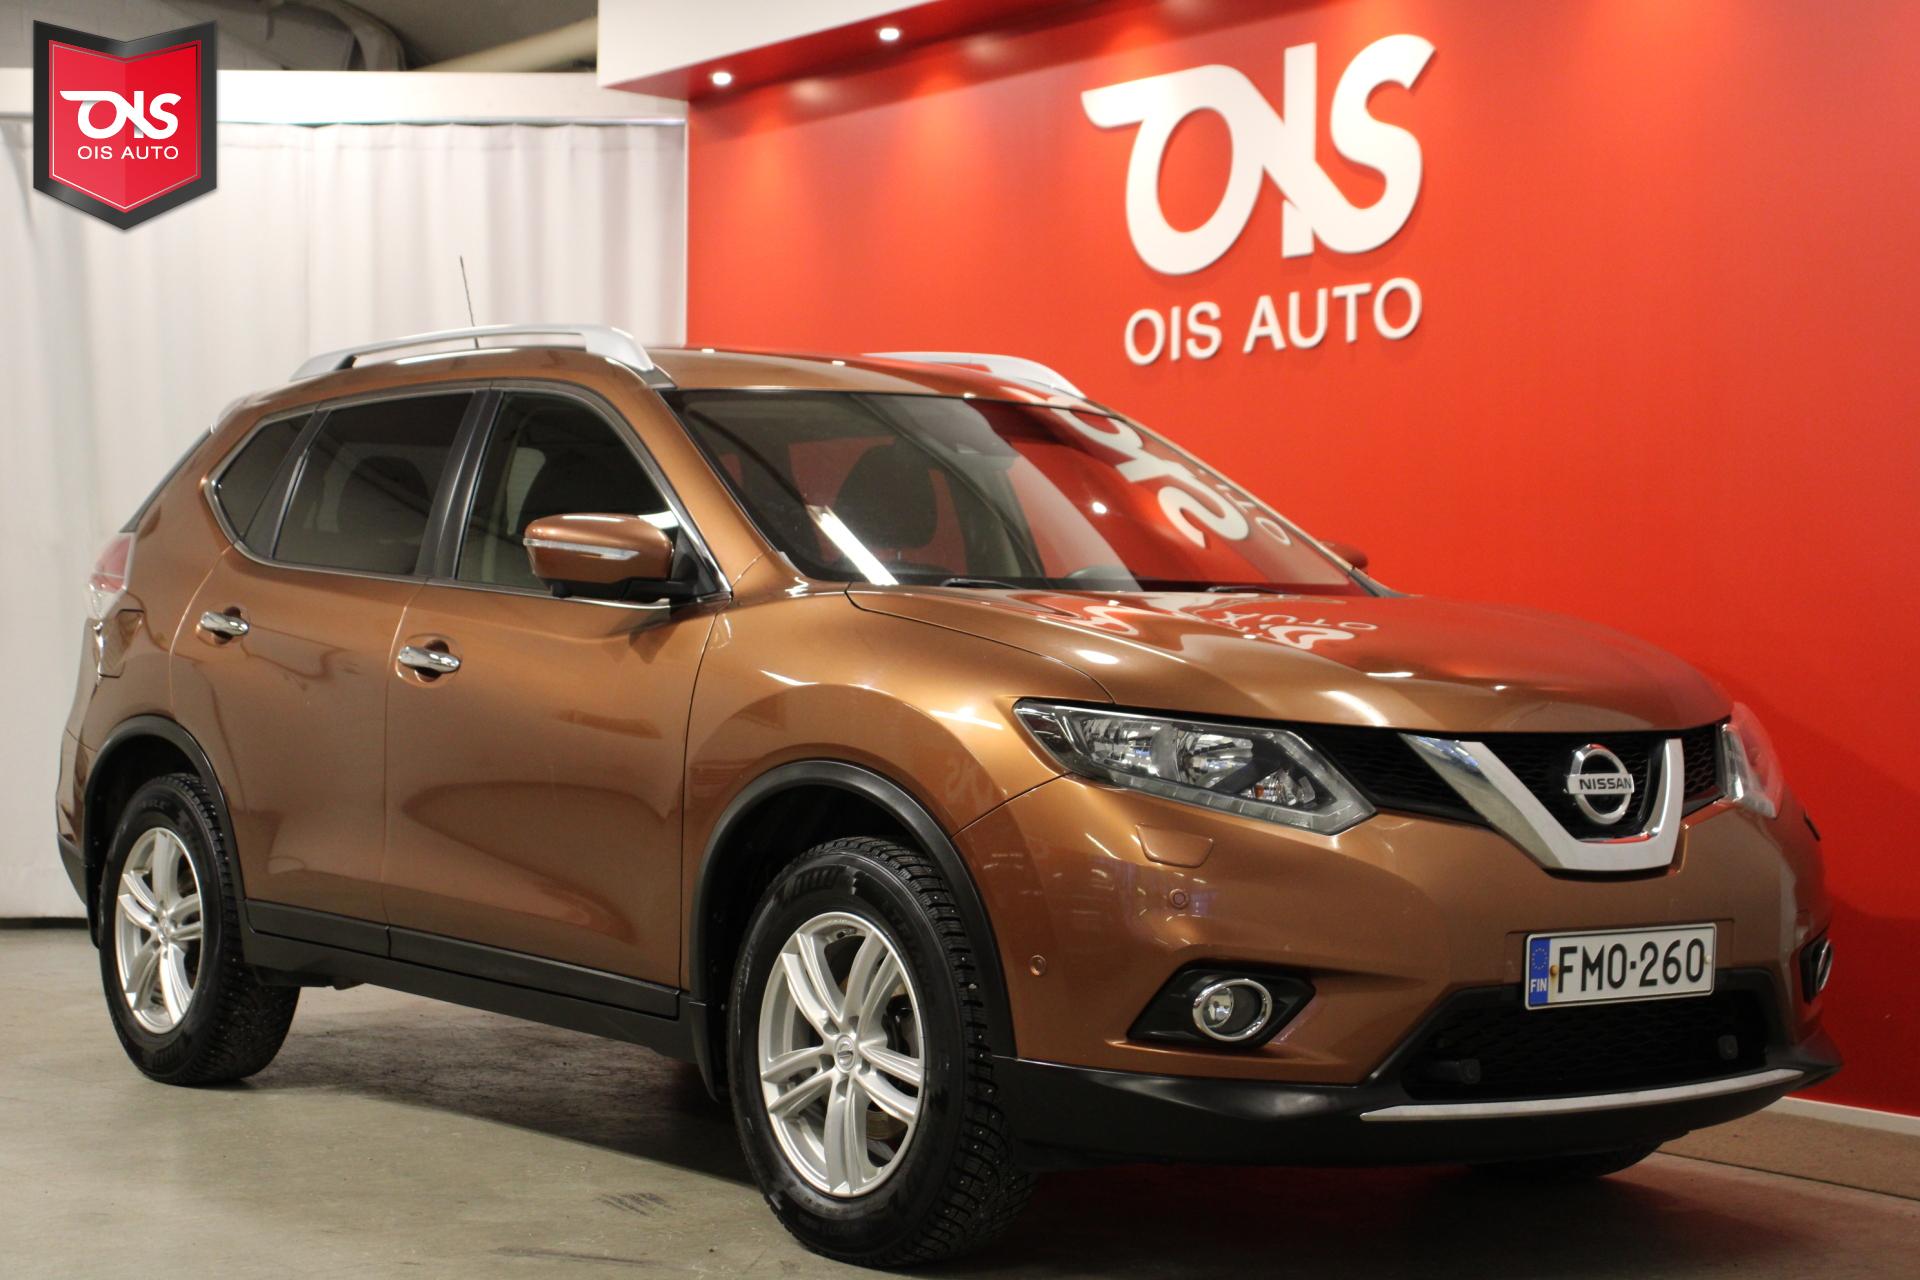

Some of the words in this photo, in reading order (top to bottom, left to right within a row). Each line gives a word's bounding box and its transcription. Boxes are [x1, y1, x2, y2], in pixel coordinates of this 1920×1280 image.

[1123, 301, 1222, 366] OIS
[1242, 277, 1423, 354] AUTO
[1578, 777, 1634, 791] NISSAN
[1530, 978, 1547, 993] FIN
